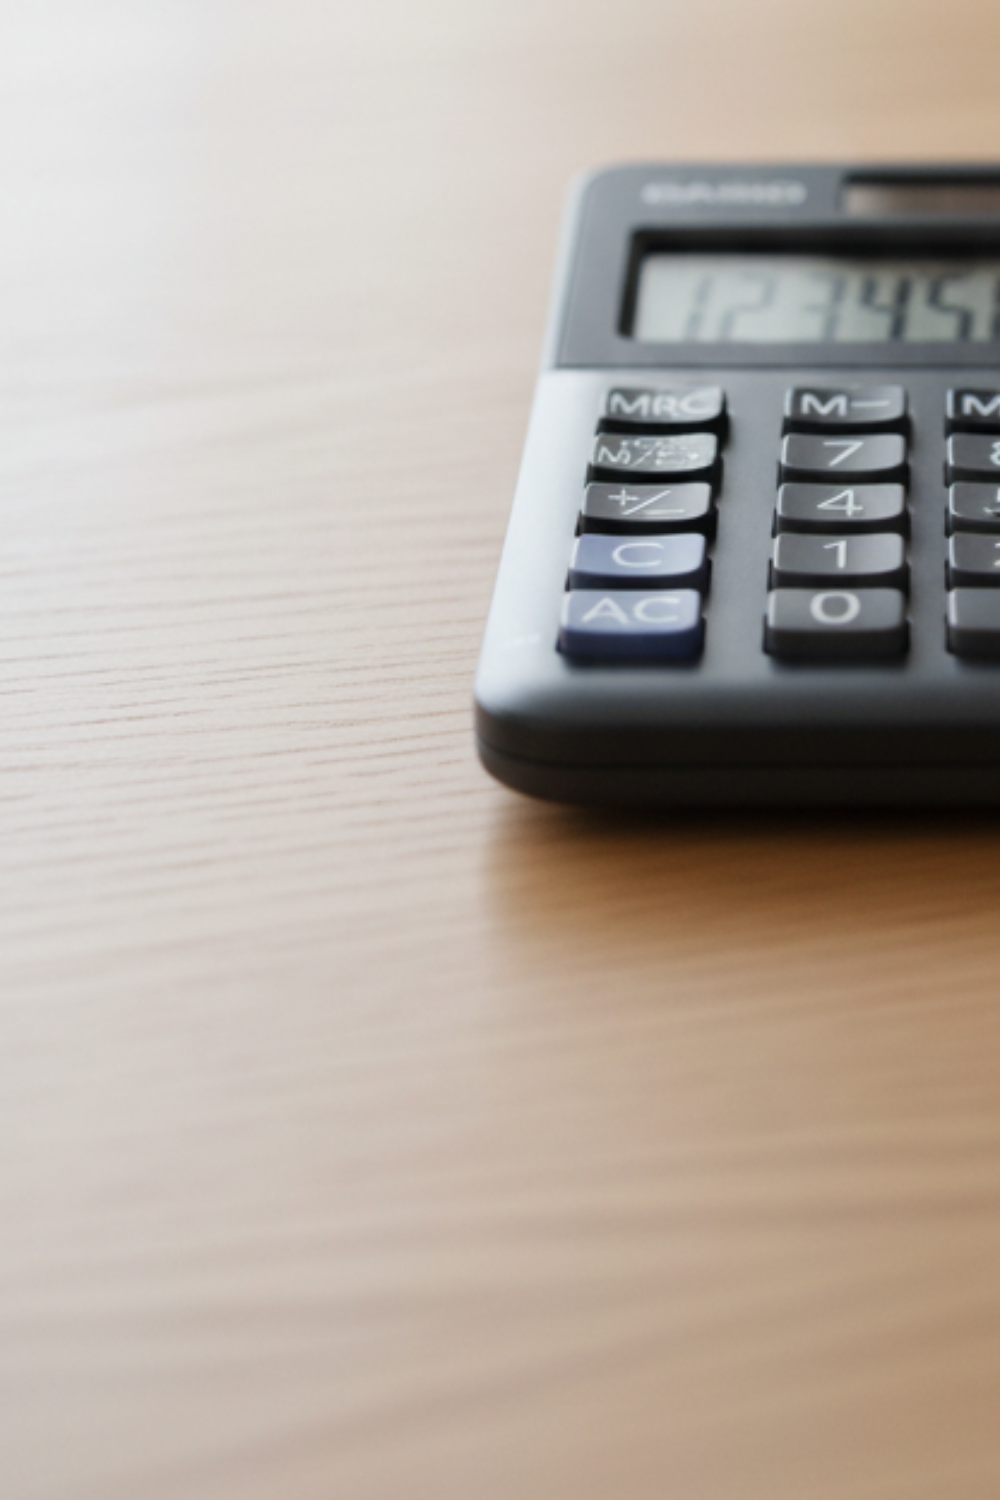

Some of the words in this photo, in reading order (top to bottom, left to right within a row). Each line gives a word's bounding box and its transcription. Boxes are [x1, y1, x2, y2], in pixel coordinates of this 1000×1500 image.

[609, 391, 718, 417] MRC
[822, 440, 865, 467] 7
[817, 489, 863, 517] 4
[612, 542, 664, 568] C
[823, 540, 848, 569] 1
[582, 596, 683, 626] AC
[810, 591, 862, 625] 0
